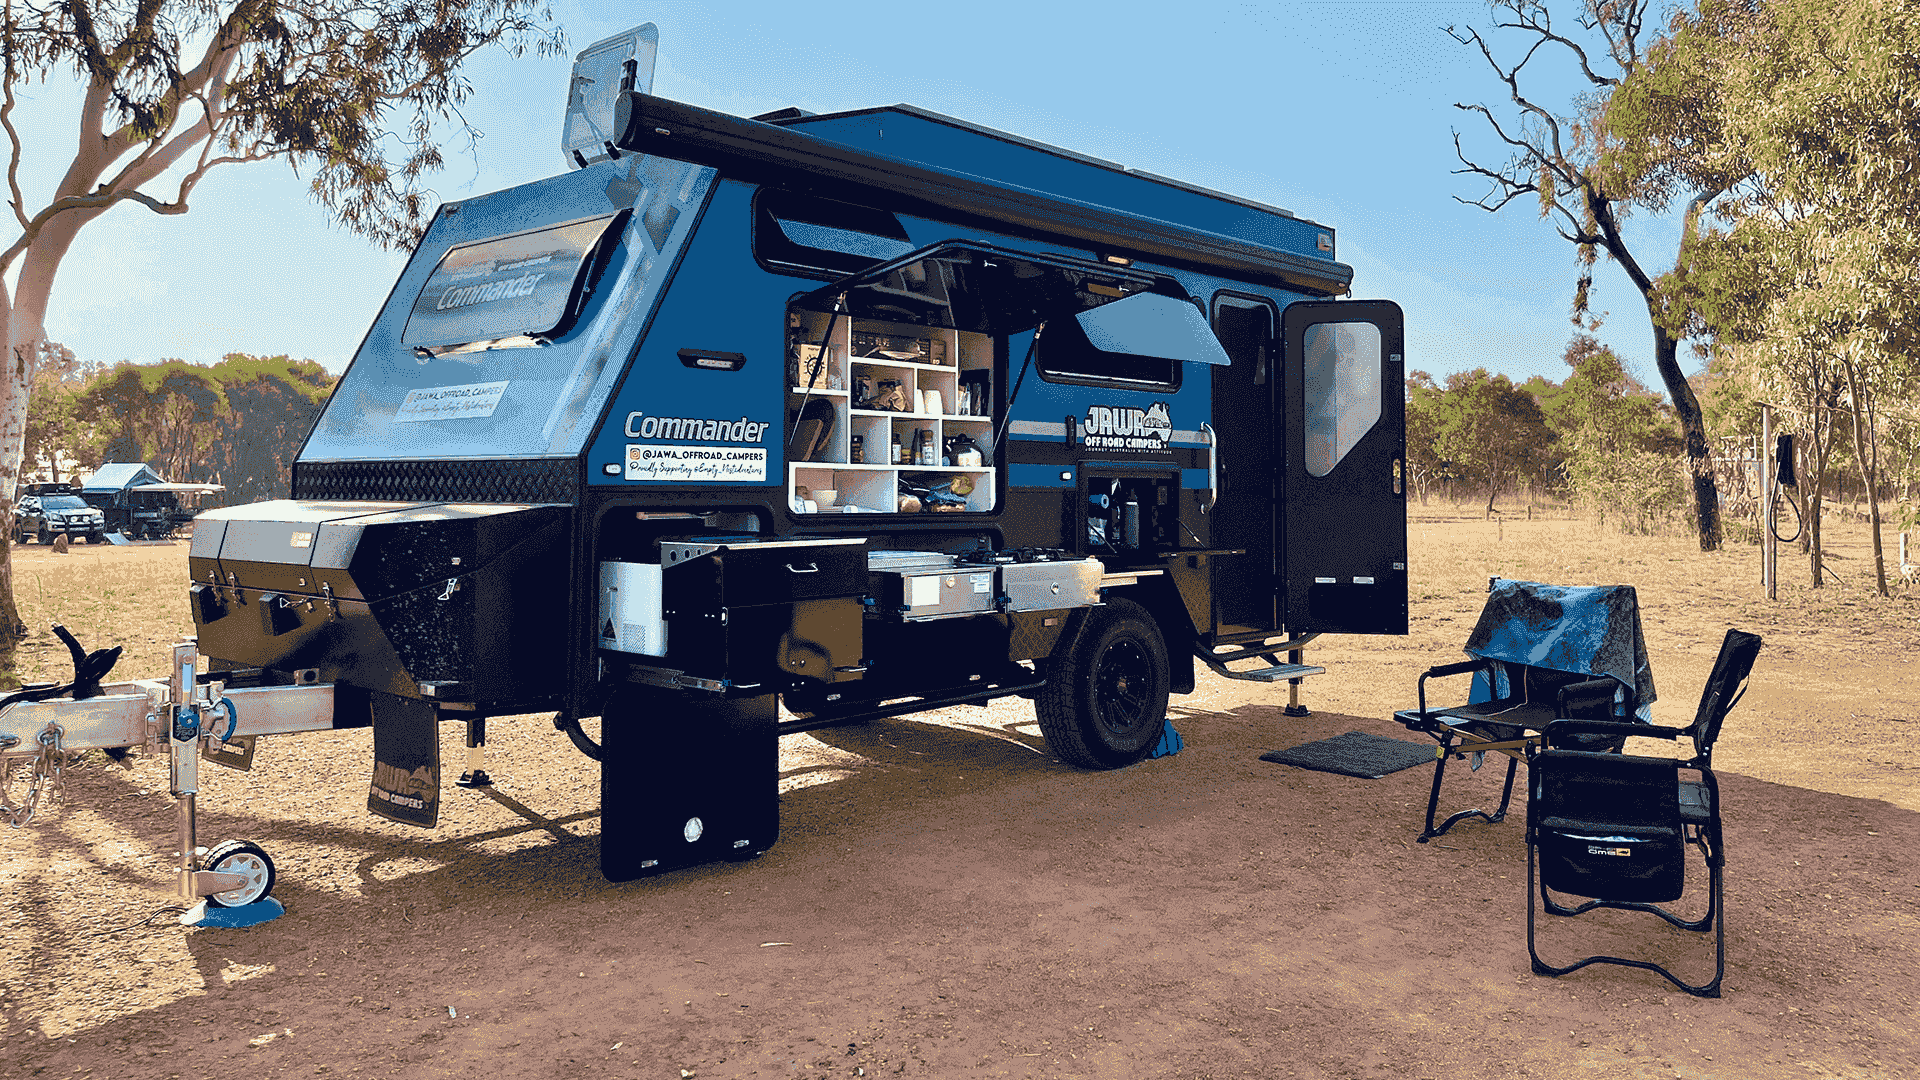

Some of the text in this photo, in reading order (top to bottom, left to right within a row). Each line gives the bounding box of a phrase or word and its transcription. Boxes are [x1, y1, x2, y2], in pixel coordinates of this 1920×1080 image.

[437, 272, 546, 311] Commander
[625, 411, 769, 442] Commander
[1085, 407, 1146, 436] JAWA
[1085, 436, 1161, 449] OFF ROAD CAMPERS
[642, 449, 763, 460] @JAWA_OFFROAD_CAMPERS
[630, 461, 658, 478] Proudly
